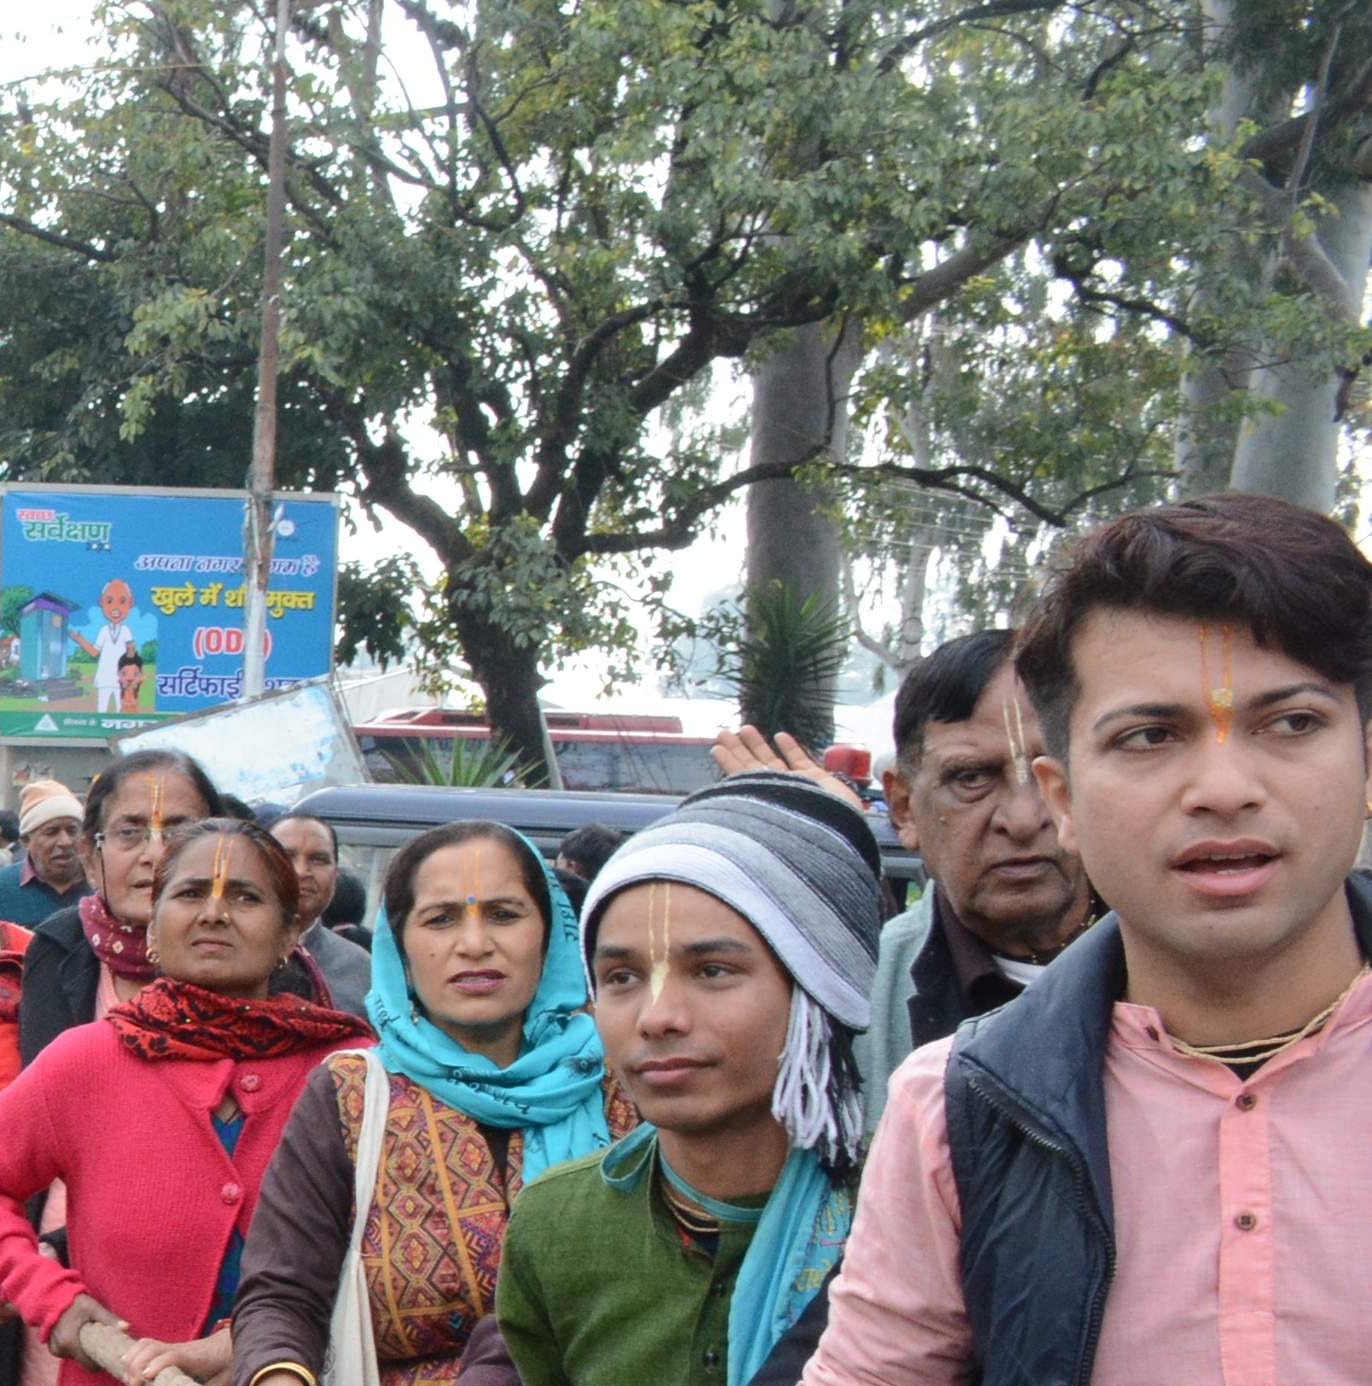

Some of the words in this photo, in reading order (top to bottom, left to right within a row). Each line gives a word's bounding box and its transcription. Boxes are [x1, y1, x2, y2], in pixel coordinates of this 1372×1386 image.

[24, 513, 112, 542] सर्वेक्षण
[134, 554, 193, 571] अपना
[300, 553, 321, 577] है
[150, 581, 196, 614] खुले
[200, 581, 222, 609] में
[266, 591, 315, 618] मुक्त
[193, 626, 272, 662] (OD)
